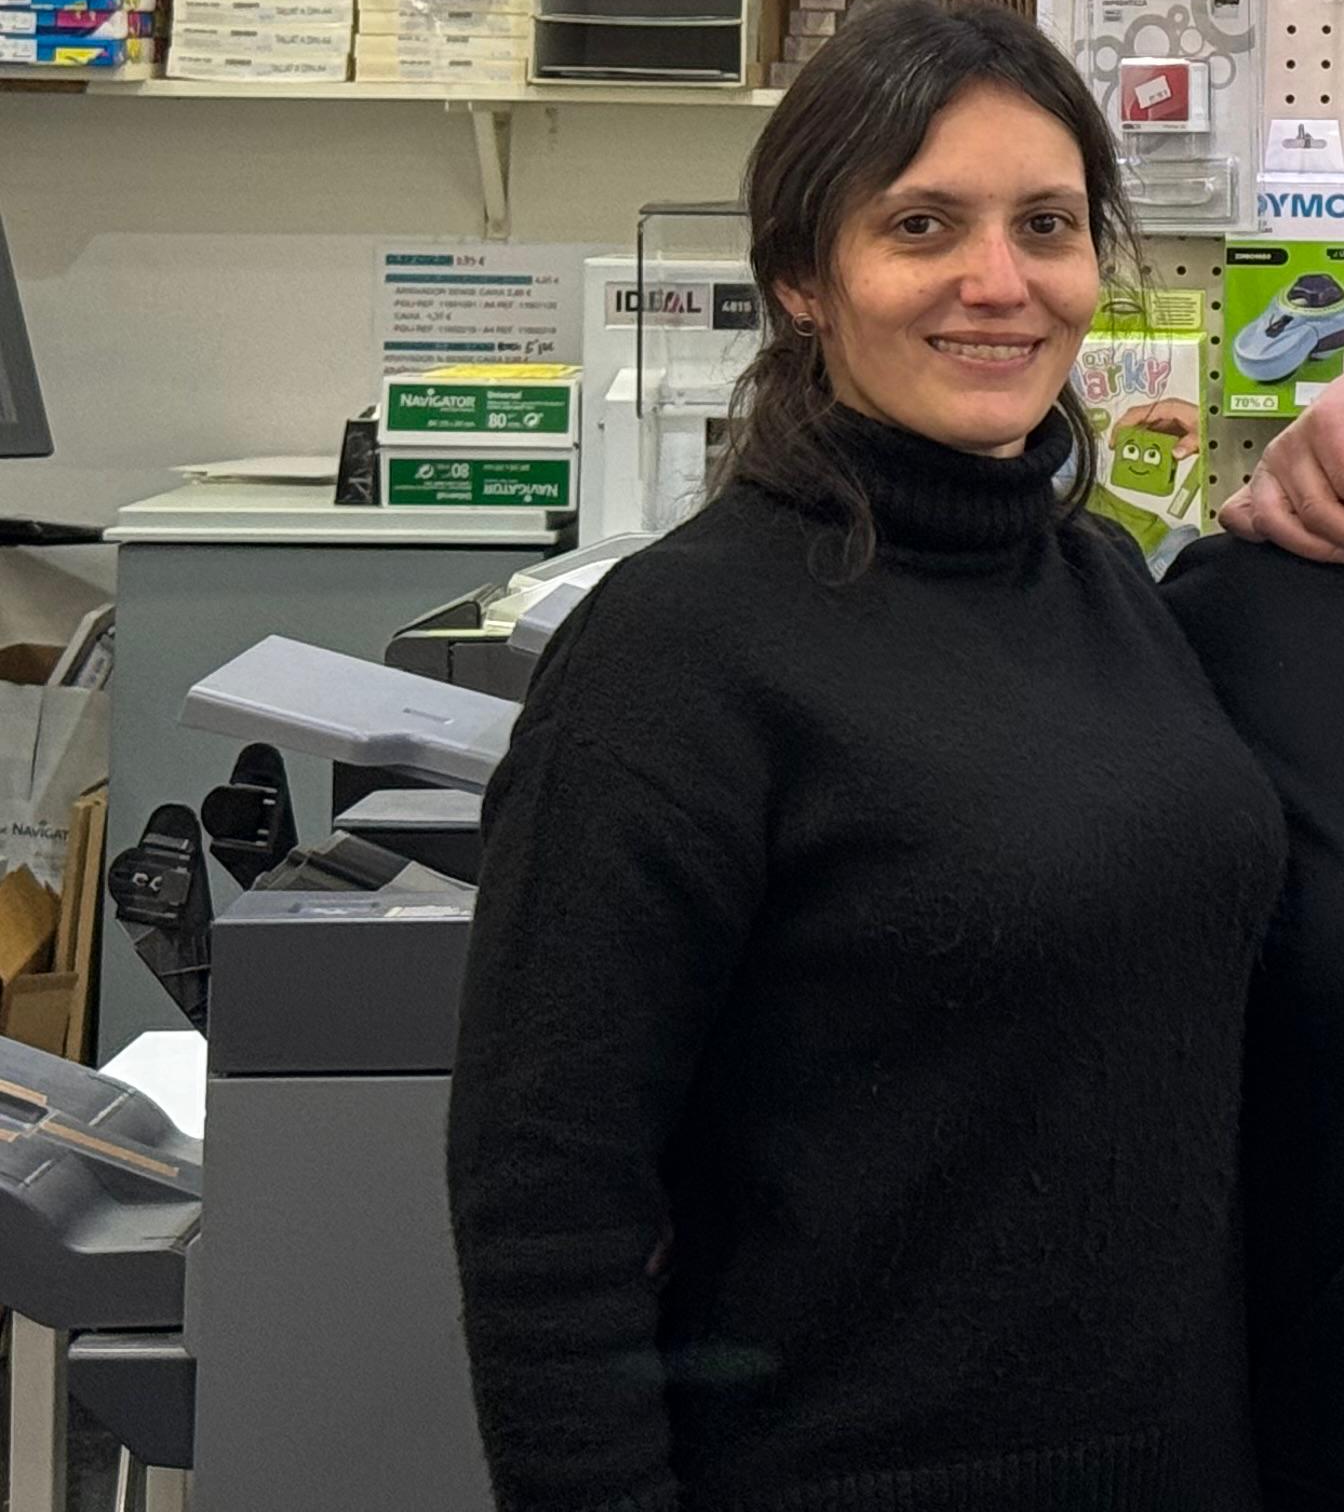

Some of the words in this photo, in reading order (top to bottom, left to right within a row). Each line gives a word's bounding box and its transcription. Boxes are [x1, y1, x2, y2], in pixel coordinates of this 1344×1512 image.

[401, 389, 475, 407] NAVIGATOR
[1235, 399, 1261, 408] 70%
[488, 413, 507, 428] 80
[452, 463, 470, 478] 80
[483, 484, 558, 503] NAVIGATOR
